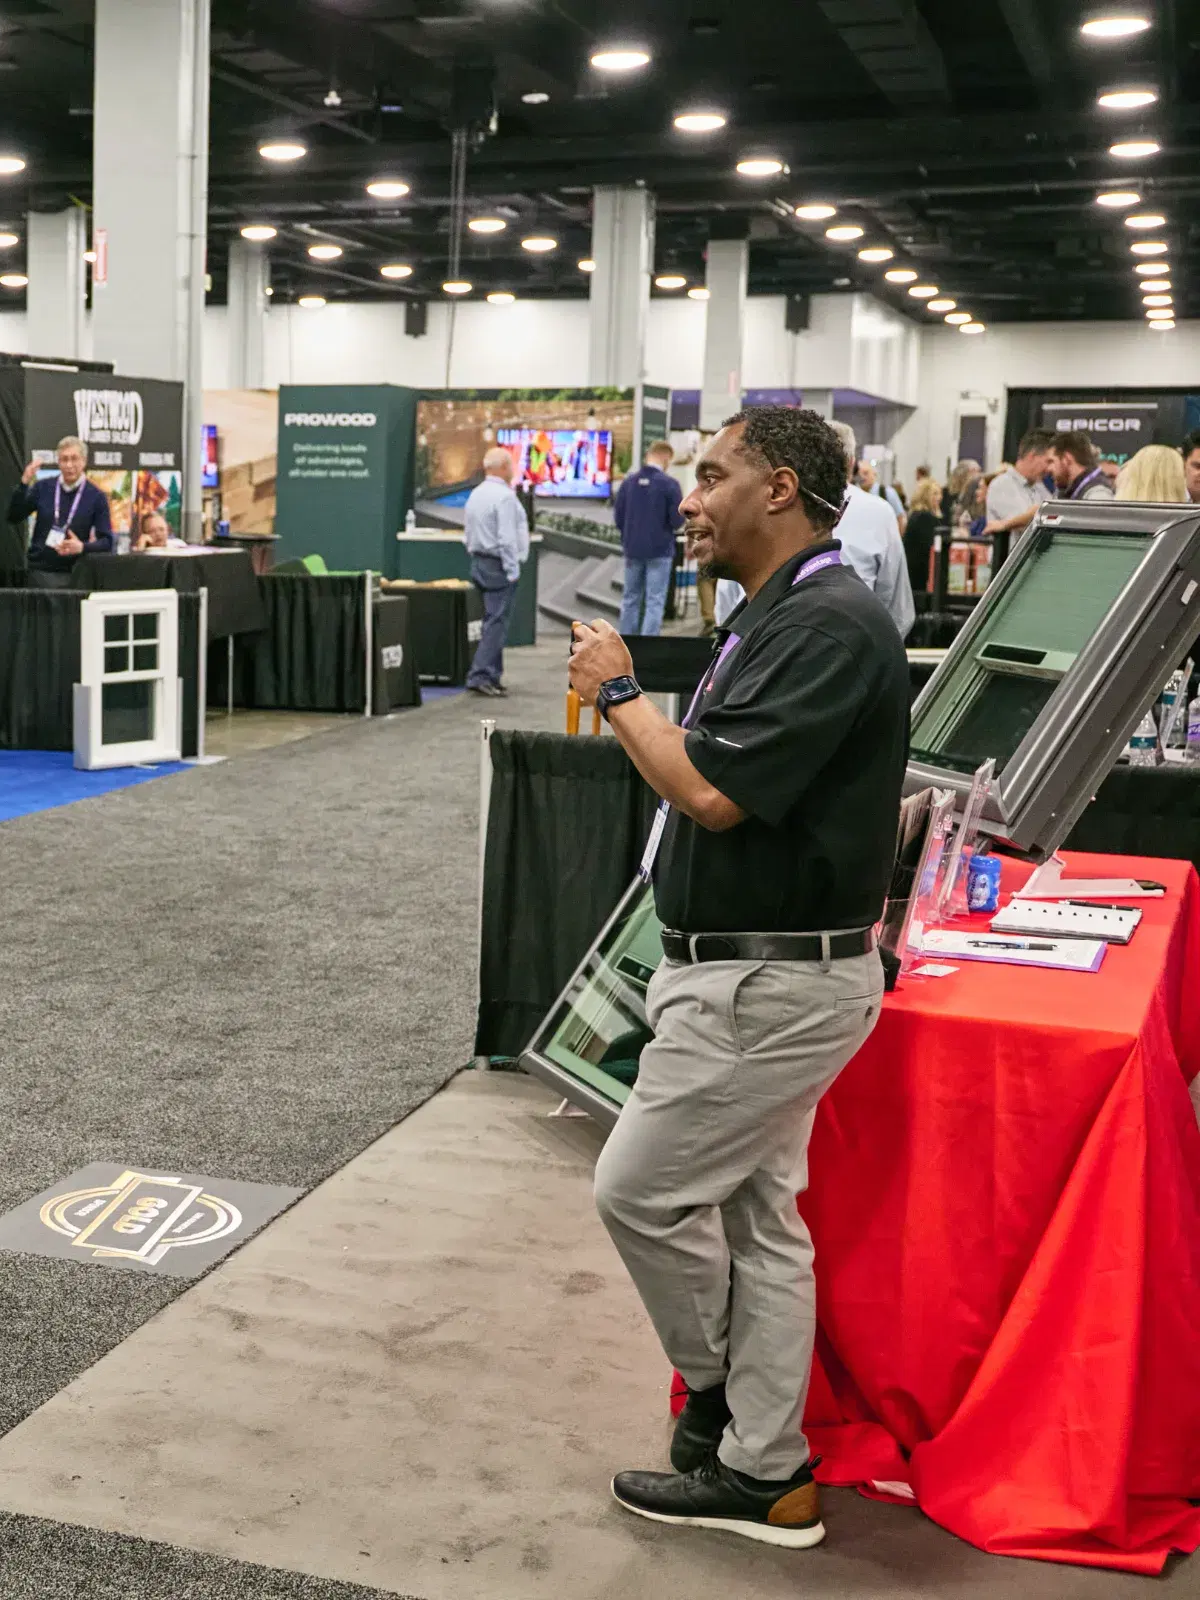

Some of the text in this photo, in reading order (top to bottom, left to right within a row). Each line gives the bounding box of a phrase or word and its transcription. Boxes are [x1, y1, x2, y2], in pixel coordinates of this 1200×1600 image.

[73, 388, 144, 446] WESTWOOD
[284, 412, 377, 427] PROWOOD
[1055, 418, 1142, 432] EPICOR
